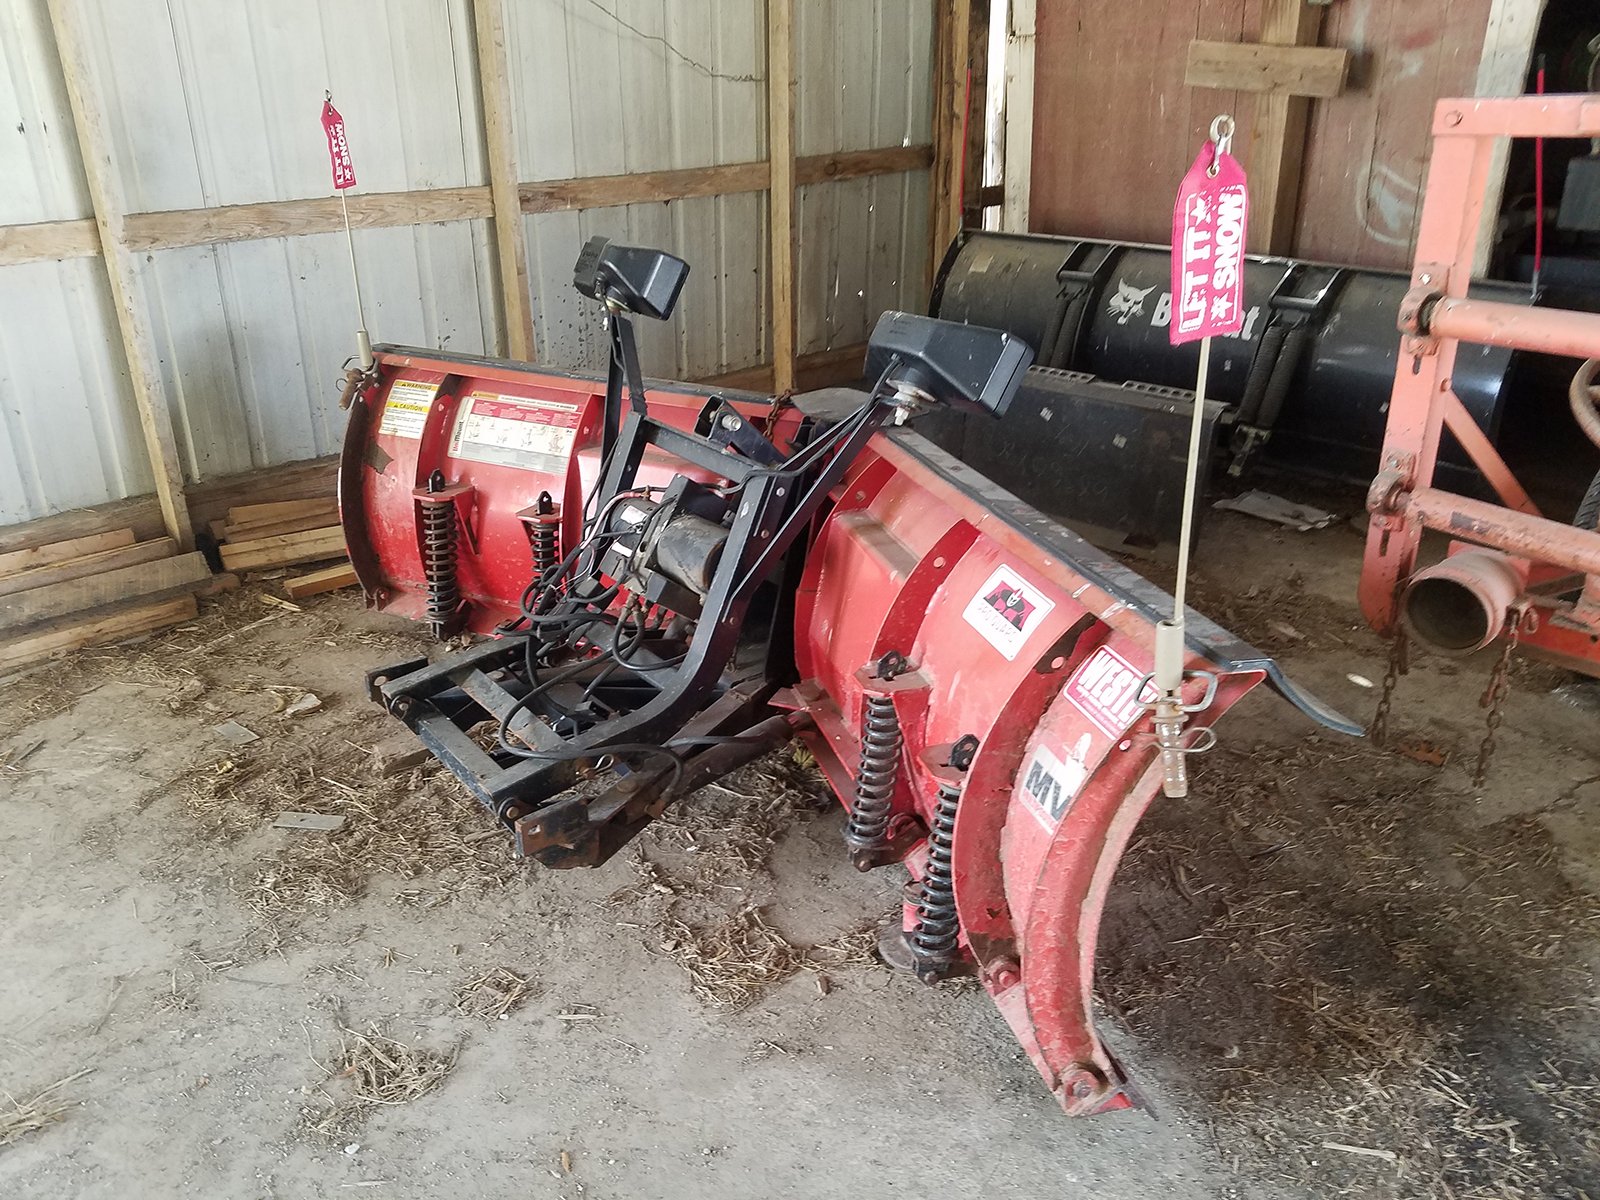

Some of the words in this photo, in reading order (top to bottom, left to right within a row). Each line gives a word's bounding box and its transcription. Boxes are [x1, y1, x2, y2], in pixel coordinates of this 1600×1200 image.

[332, 137, 340, 153] IT
[335, 122, 351, 166] SNOW
[335, 156, 344, 184] LET
[1186, 227, 1211, 263] IT
[1212, 192, 1244, 290] SNOW
[1181, 271, 1209, 330] LET
[406, 382, 433, 391] WARNING
[400, 403, 424, 412] CAUTION
[1025, 759, 1072, 822] MV
